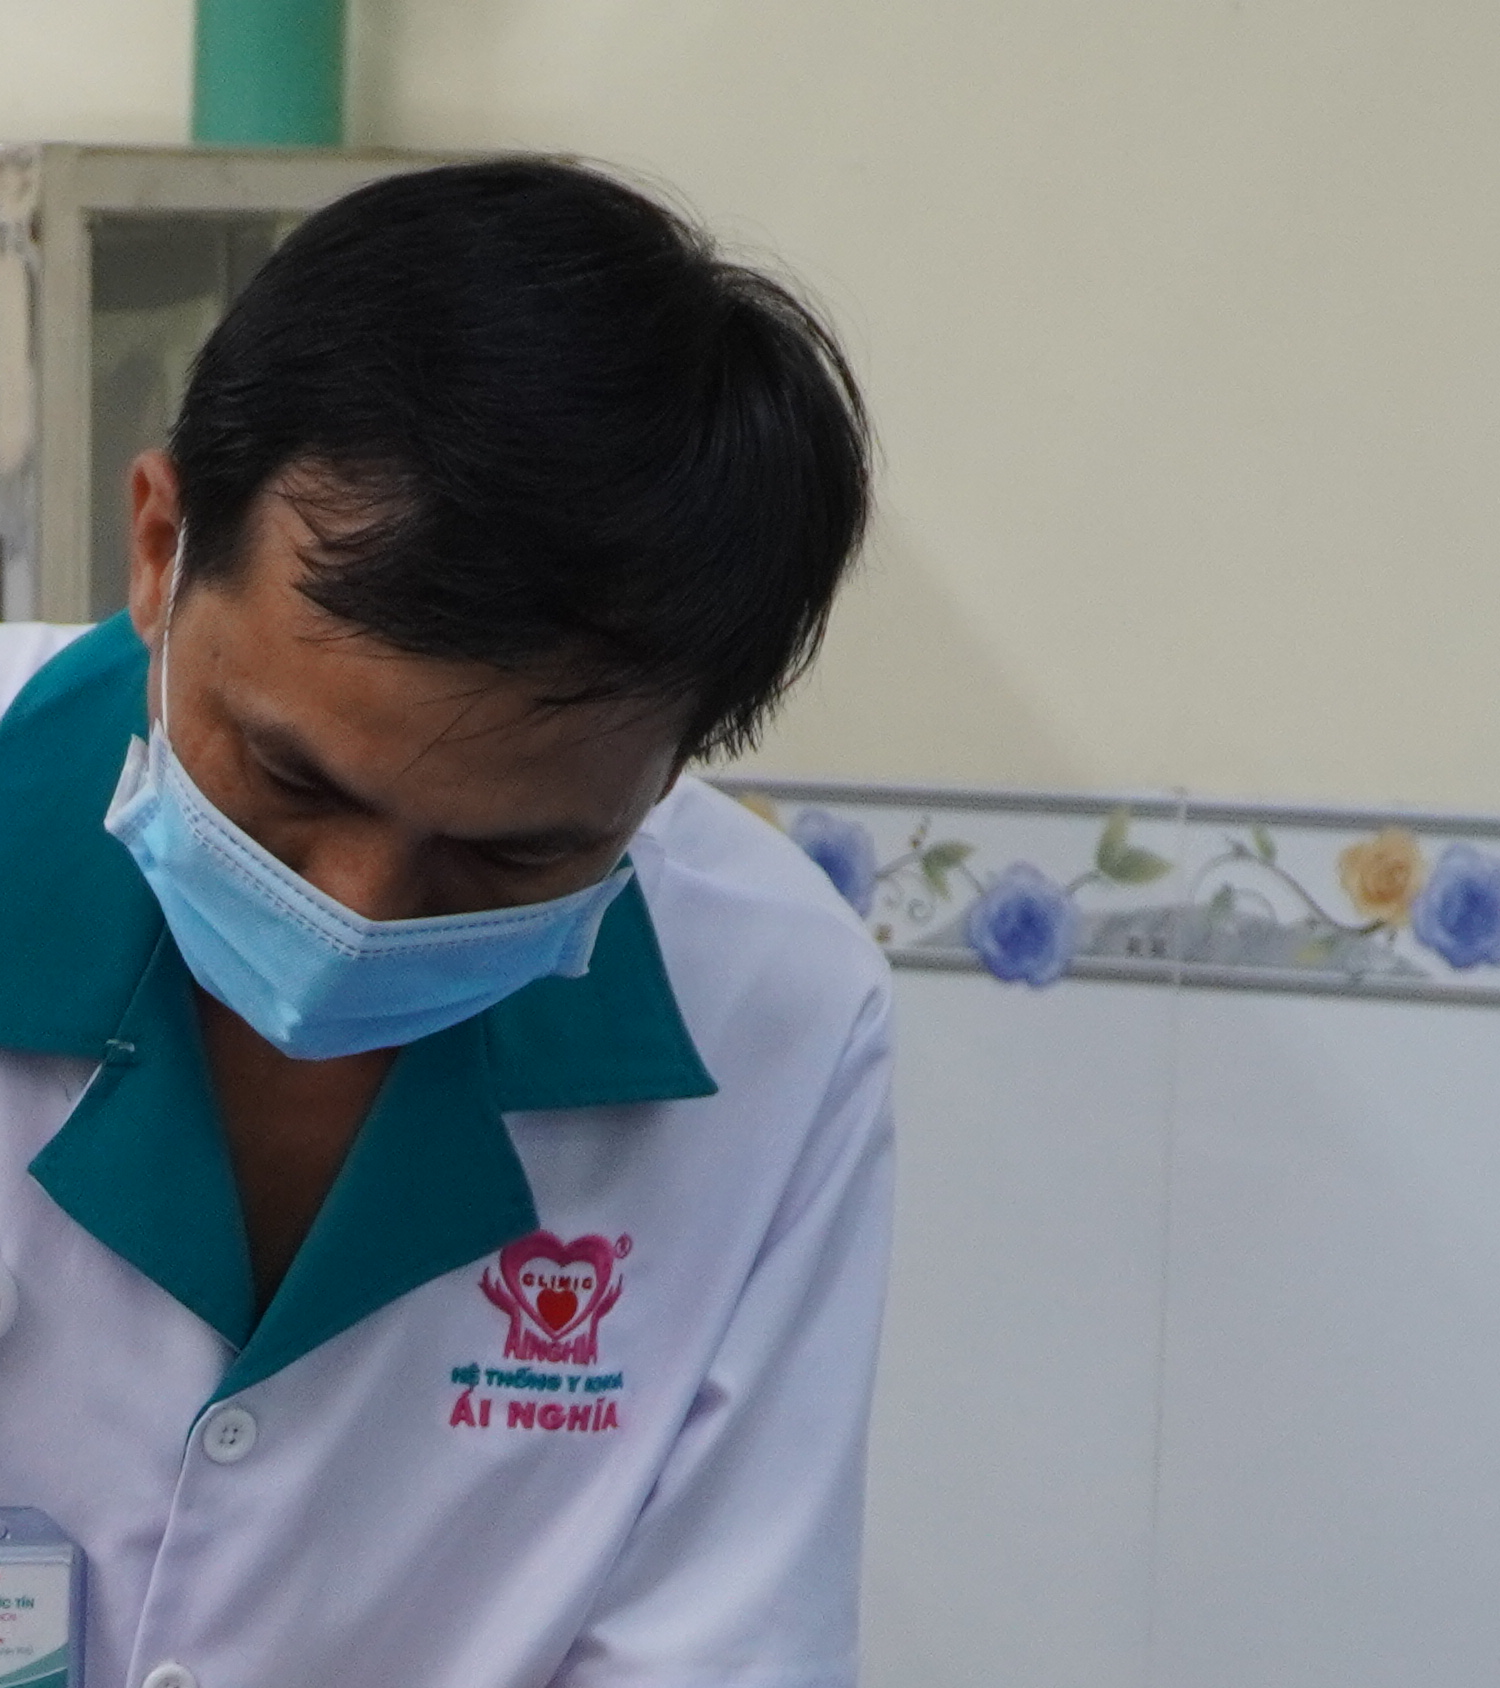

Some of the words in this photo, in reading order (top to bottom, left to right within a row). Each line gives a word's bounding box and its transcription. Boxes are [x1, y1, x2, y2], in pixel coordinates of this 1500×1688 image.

[521, 1272, 595, 1291] CLINIC
[449, 1385, 492, 1429] ÁI
[507, 1397, 620, 1432] NGHĨA
